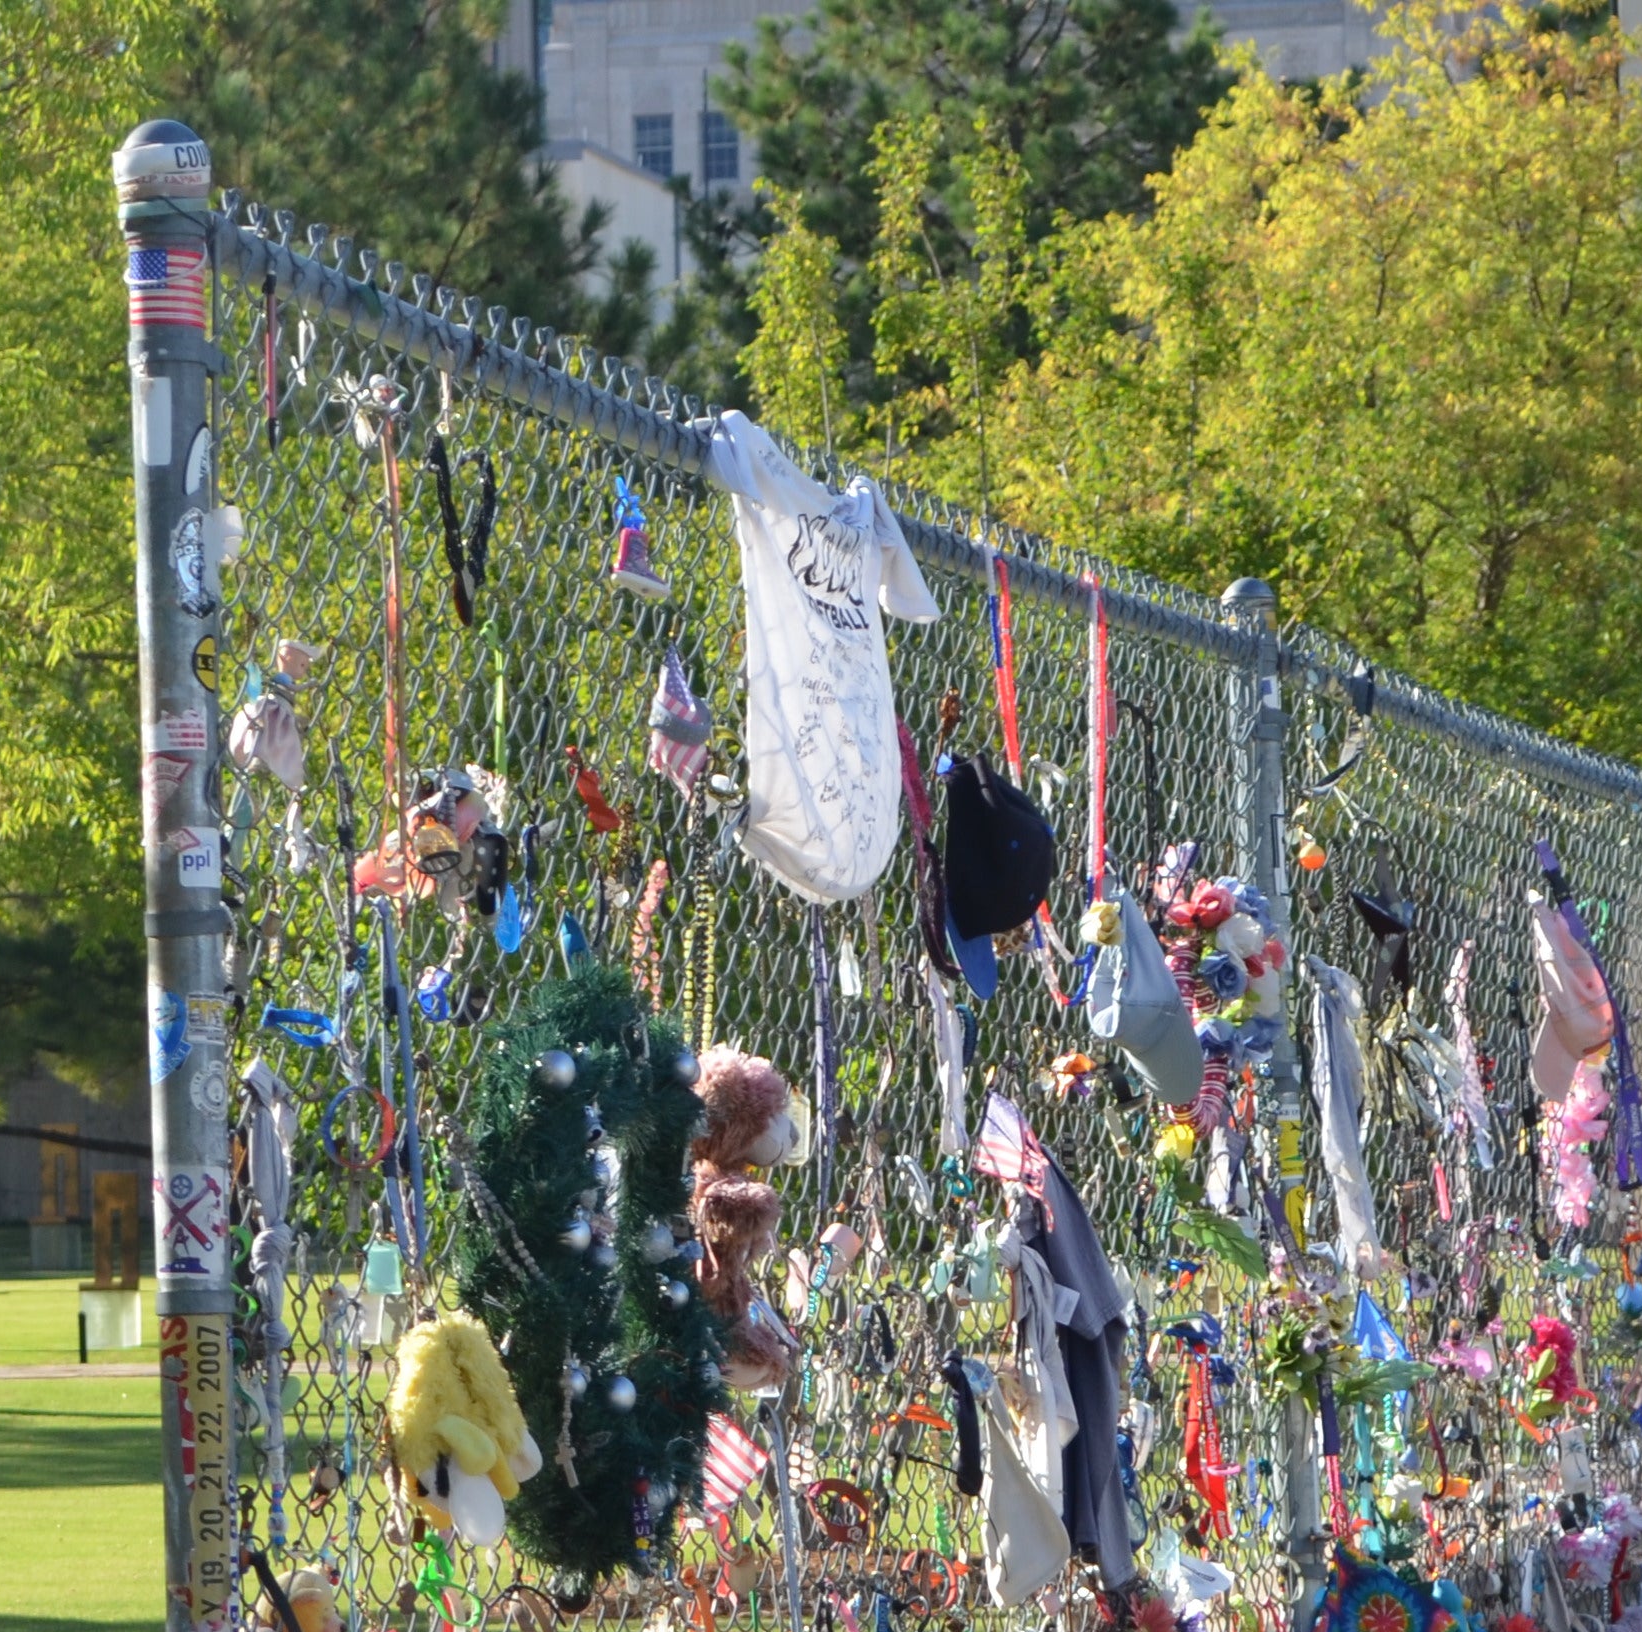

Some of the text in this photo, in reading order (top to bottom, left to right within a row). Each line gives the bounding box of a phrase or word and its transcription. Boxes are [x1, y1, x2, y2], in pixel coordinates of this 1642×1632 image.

[181, 848, 212, 876] ppl
[196, 1324, 222, 1393] 2007
[197, 1402, 225, 1445] 22,
[1205, 1408, 1215, 1430] Red
[1207, 1432, 1219, 1463] Cross
[198, 1454, 225, 1491] 21,
[200, 1552, 226, 1588] 19,
